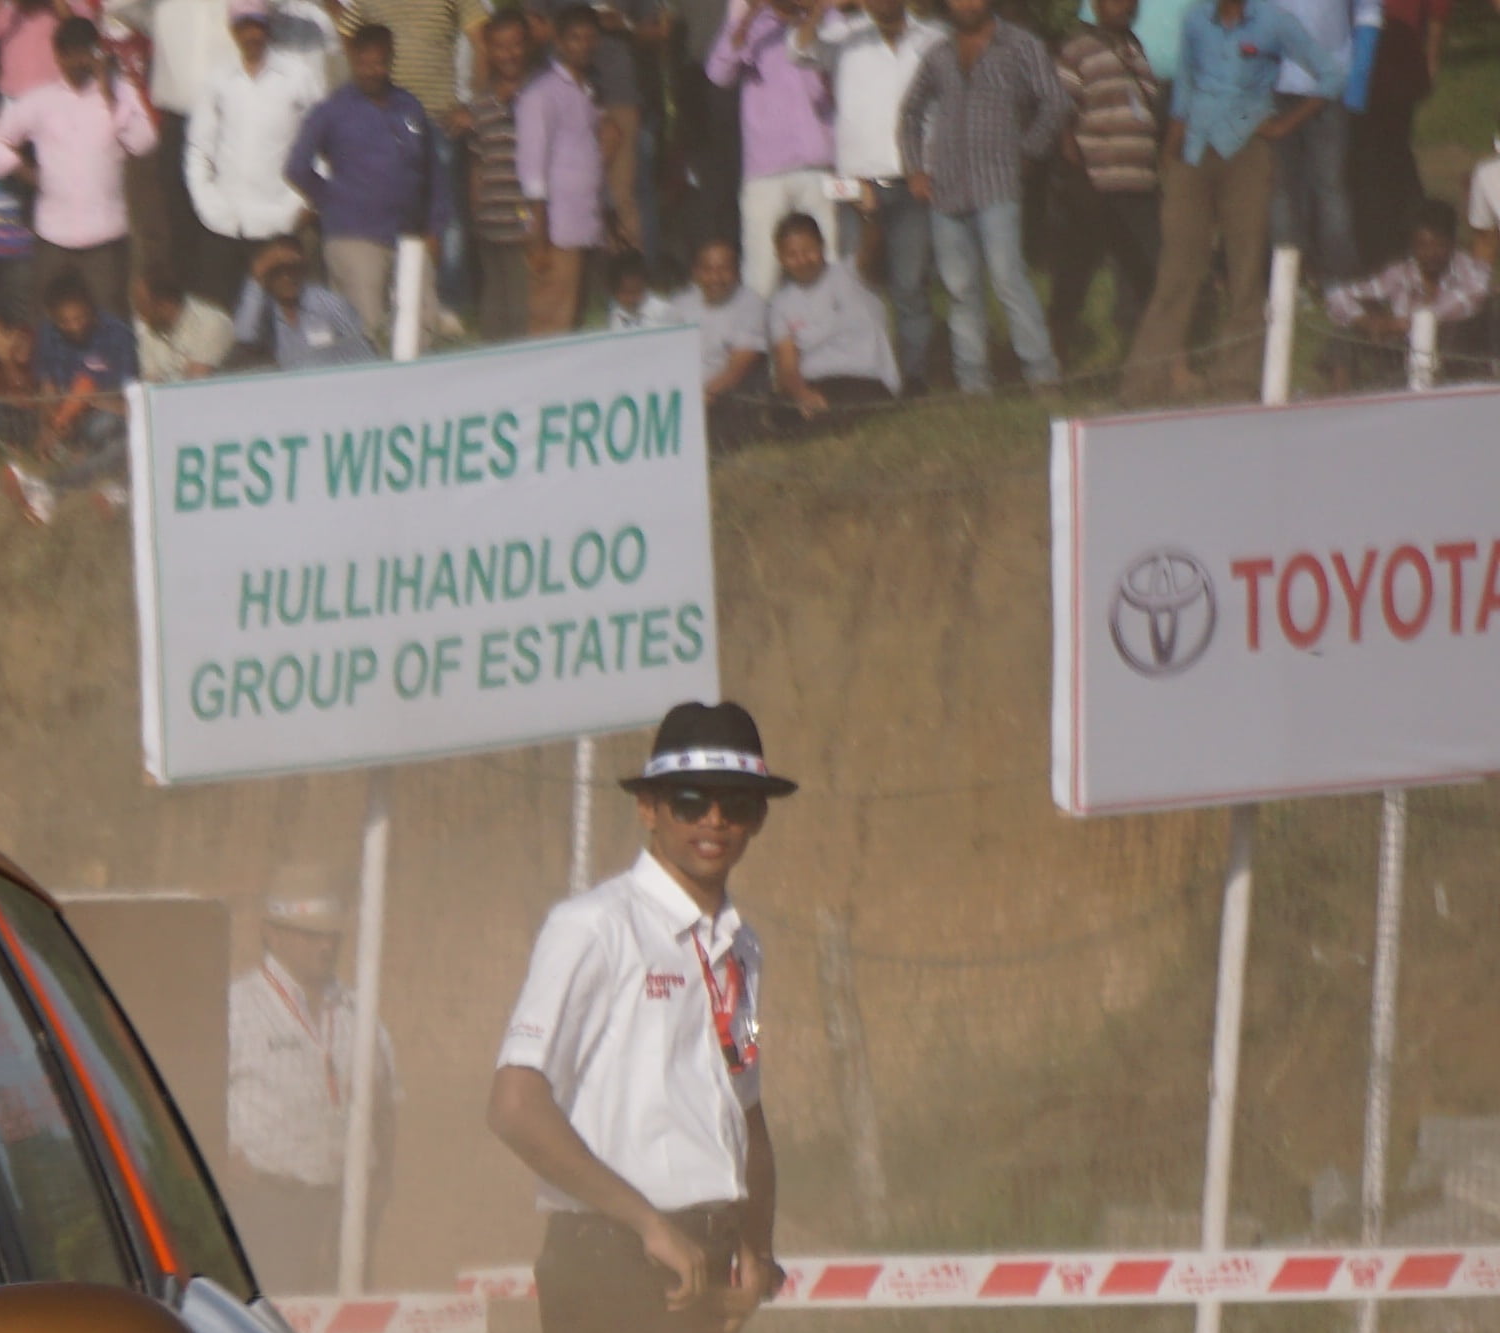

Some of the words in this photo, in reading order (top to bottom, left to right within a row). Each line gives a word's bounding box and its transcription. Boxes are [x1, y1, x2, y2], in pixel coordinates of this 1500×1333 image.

[173, 435, 309, 514] BEST
[323, 409, 520, 500] WISHES
[535, 389, 684, 475] FROM
[238, 523, 648, 631] HULLIHANDLOO
[190, 645, 379, 722] GROUP
[393, 636, 463, 703] OF
[477, 602, 705, 691] ESTATES
